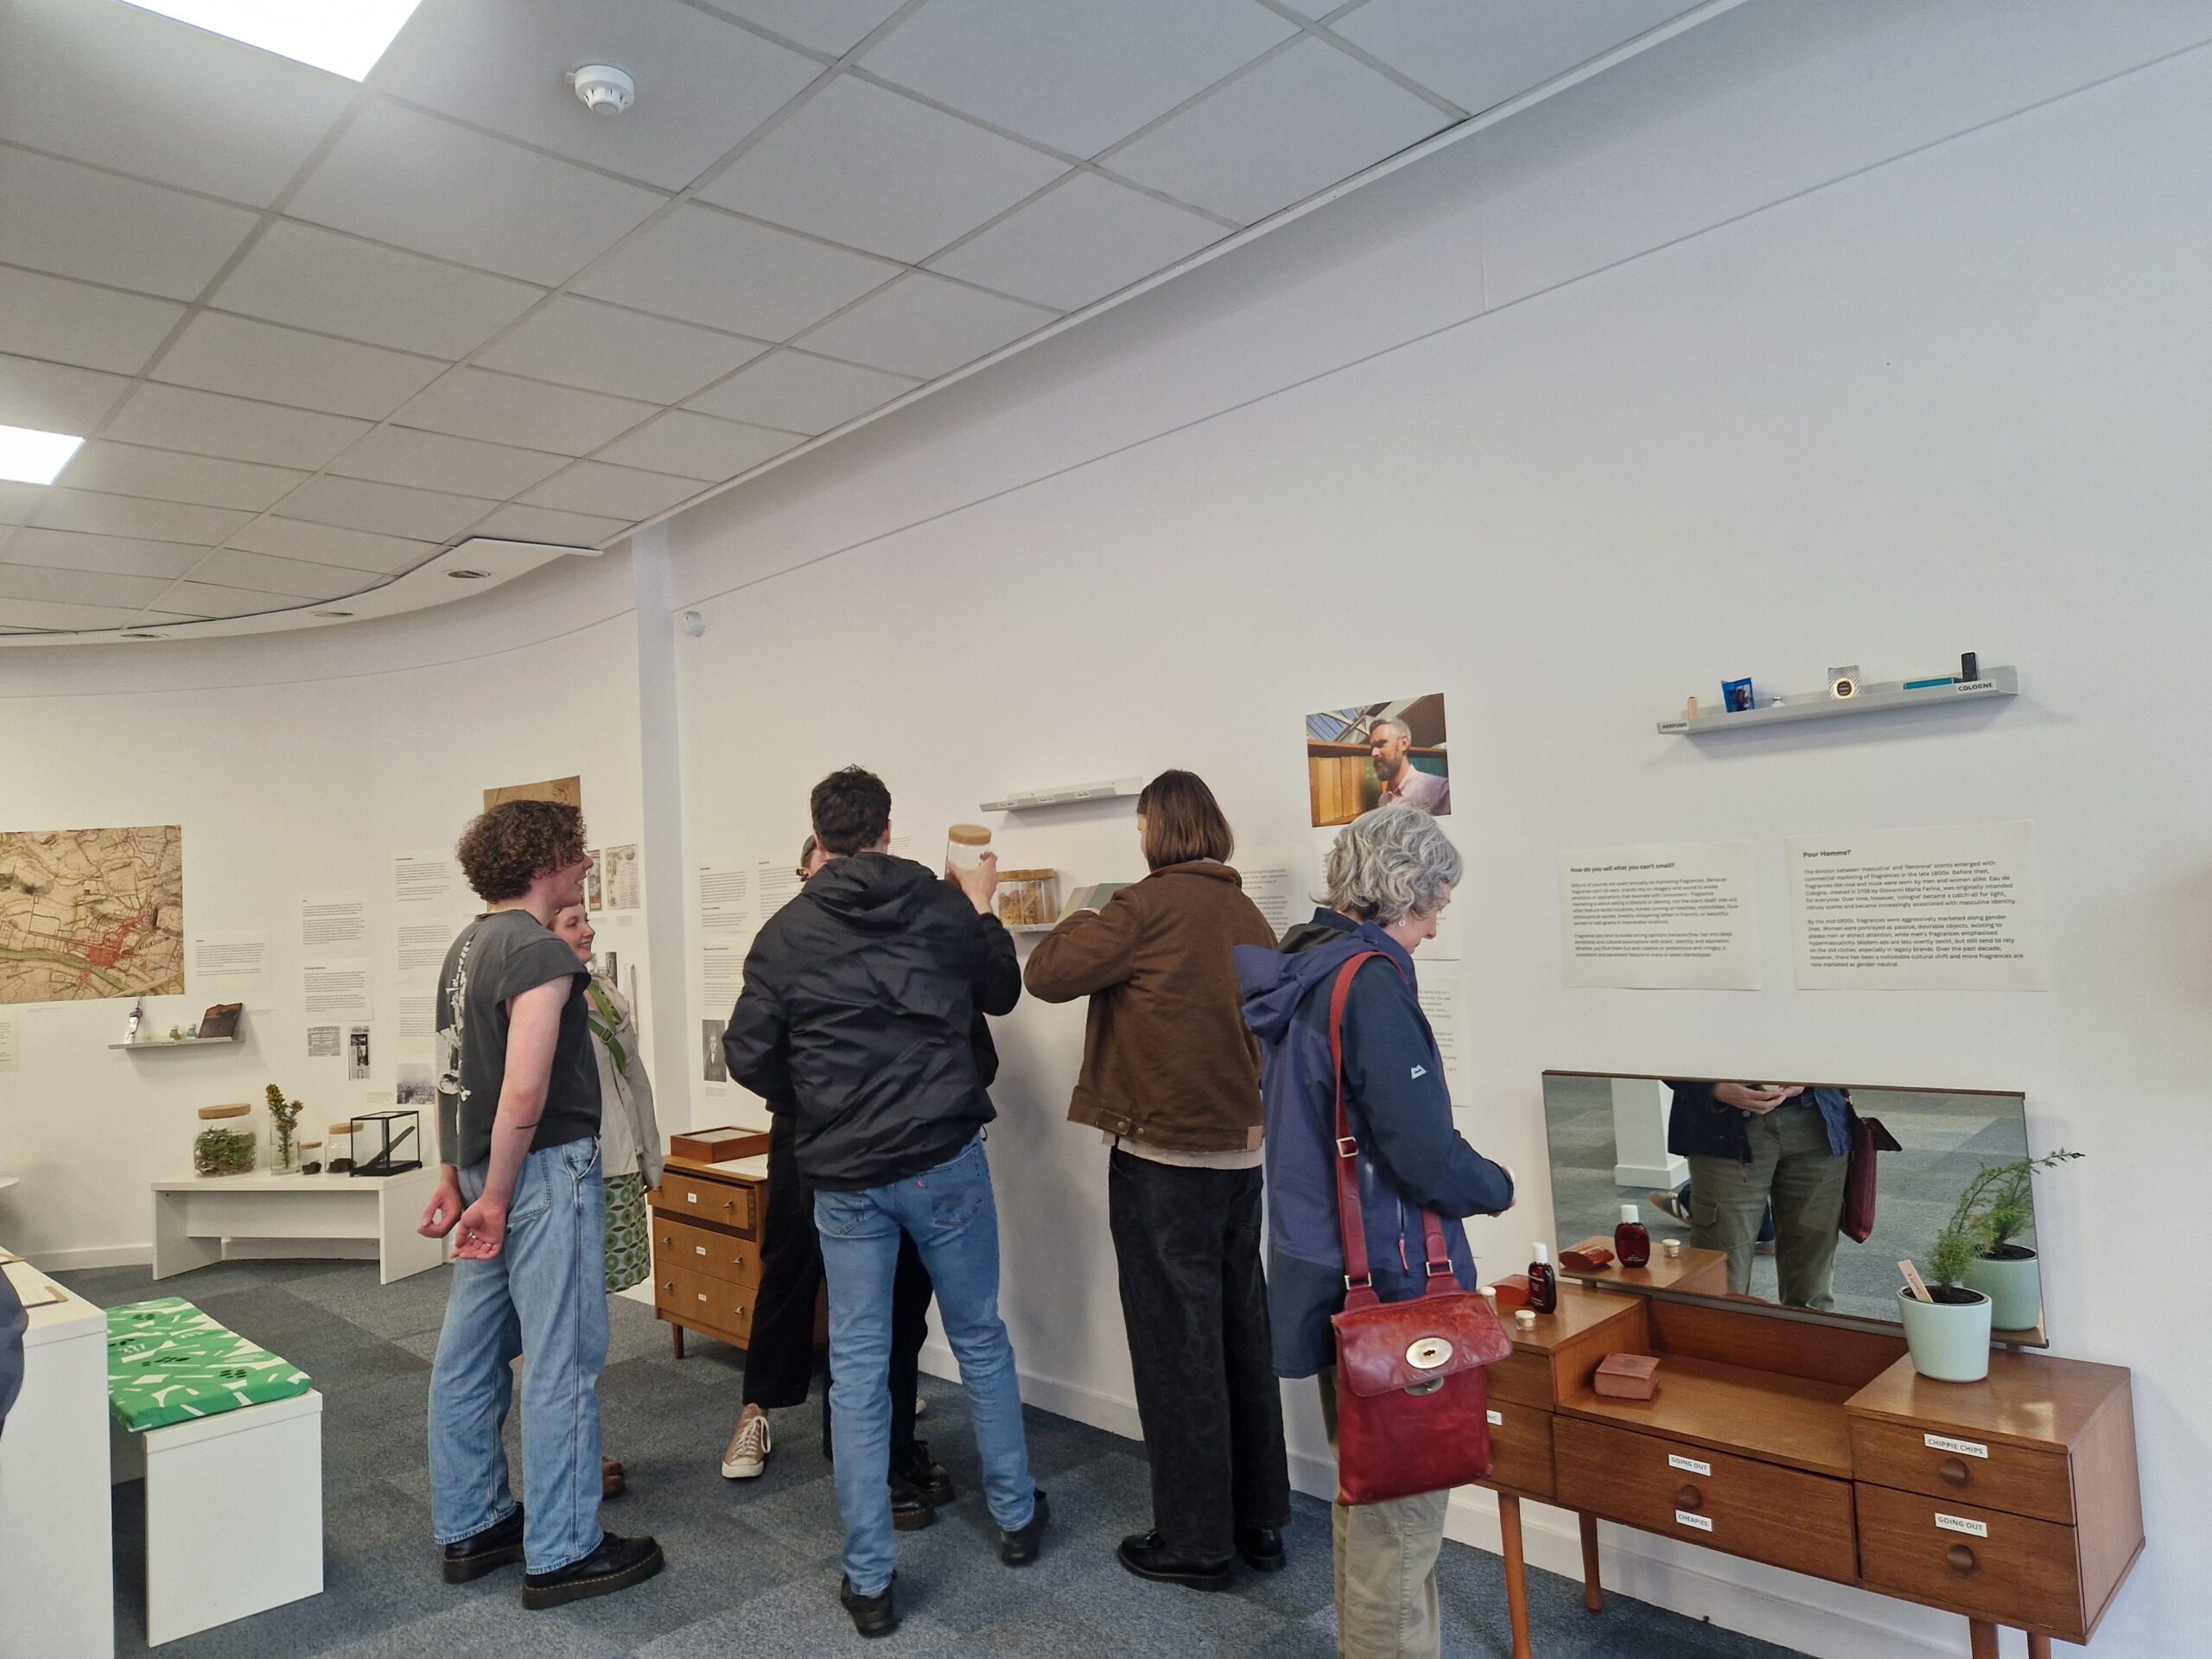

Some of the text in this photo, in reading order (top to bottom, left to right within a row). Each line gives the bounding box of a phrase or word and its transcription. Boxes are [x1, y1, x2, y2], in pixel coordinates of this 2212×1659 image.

[1959, 682, 1993, 691] COLOGNE
[1929, 1439, 1983, 1454] CHIPPIE CHIPS
[1671, 1457, 1707, 1471] GOING OUT
[1678, 1514, 1708, 1526] CHEAPIES
[1938, 1516, 1983, 1531] GOING OUT
